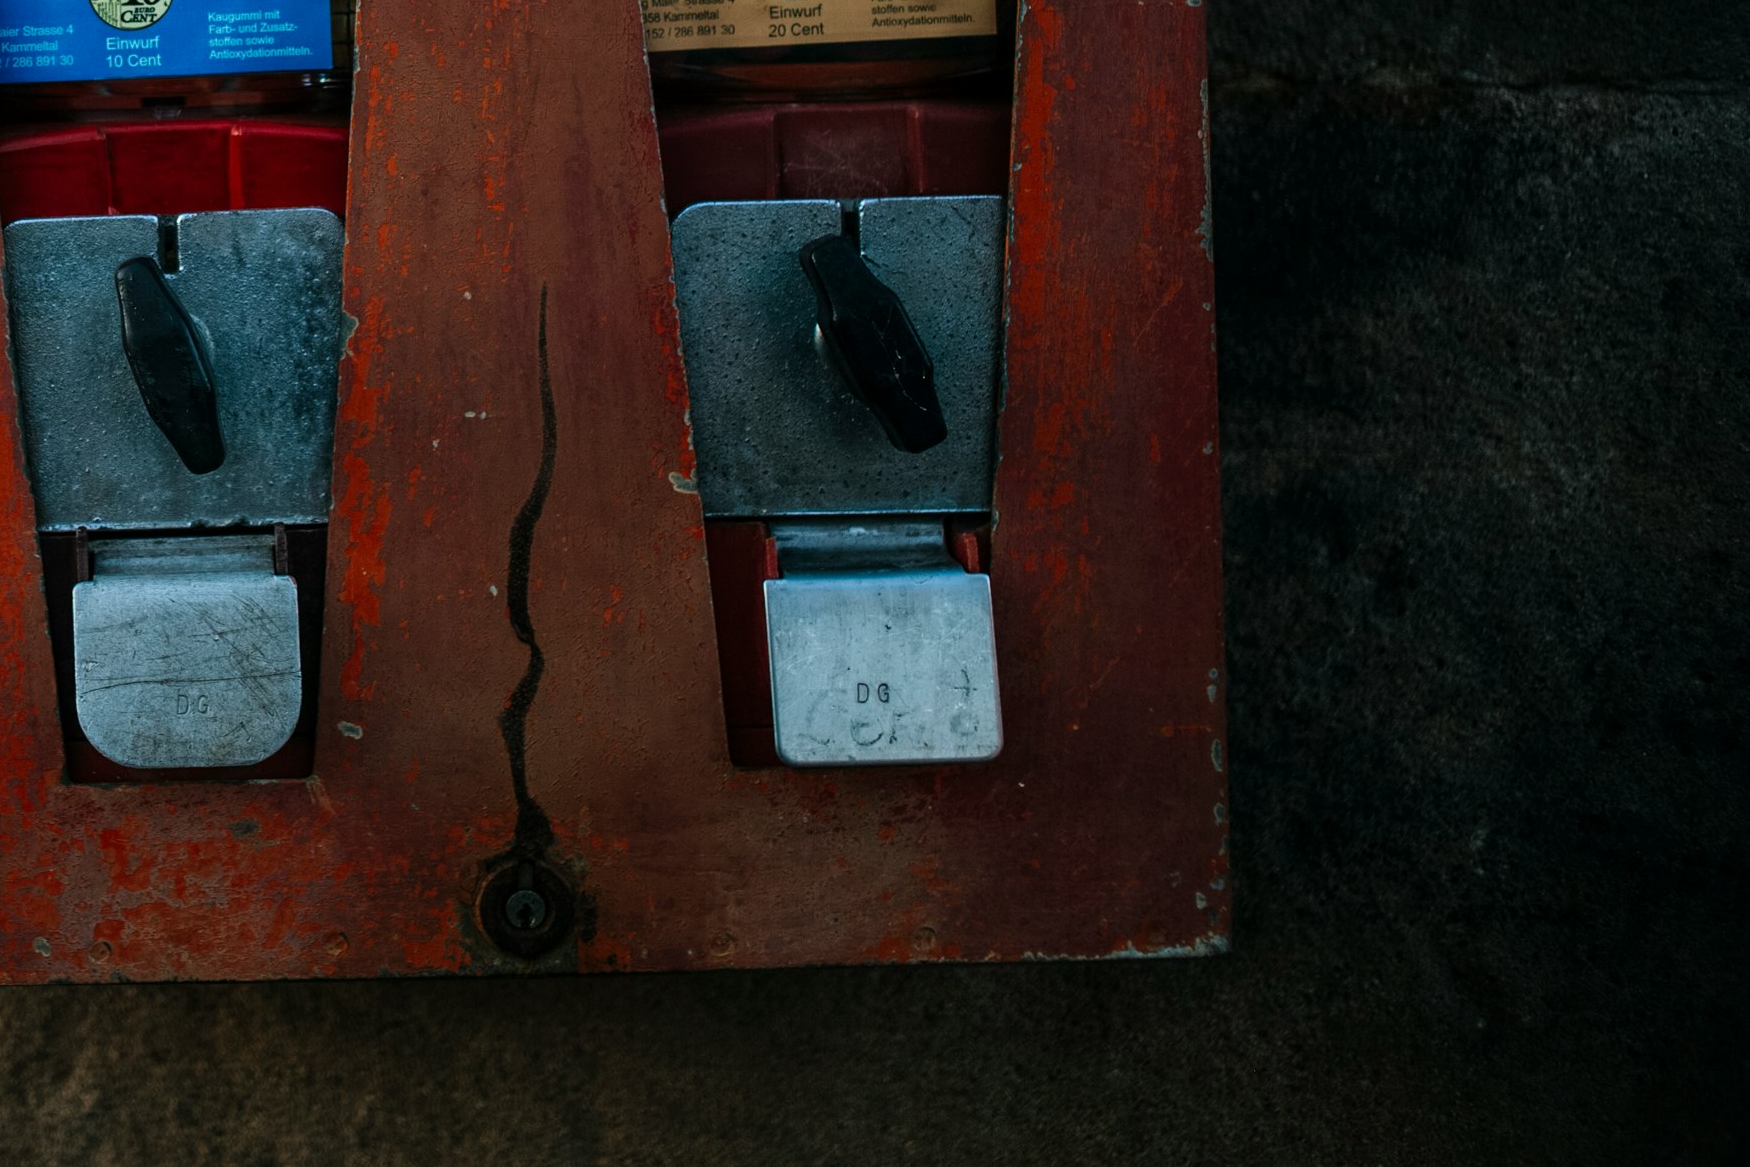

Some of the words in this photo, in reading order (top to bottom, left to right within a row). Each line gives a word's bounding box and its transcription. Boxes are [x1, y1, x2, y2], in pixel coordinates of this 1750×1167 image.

[769, 3, 823, 19] Einwurf
[872, 4, 905, 14] stoffen
[907, 2, 937, 13] sowie
[121, 11, 158, 24] CENT
[208, 10, 262, 23] Kaugummi
[264, 9, 280, 20] mit
[664, 10, 720, 22] Kammeltal
[23, 25, 63, 36] Strasse
[66, 24, 74, 35] 4
[209, 24, 236, 35] Farb-
[238, 23, 257, 33] und
[260, 22, 298, 33] Zusatz-
[674, 26, 694, 38] 286
[697, 25, 717, 37] 891
[721, 24, 736, 36] 30
[768, 25, 786, 38] 20
[791, 22, 825, 36] Cent
[2, 40, 58, 53] Kammeltal
[106, 35, 160, 50] Einwurf
[210, 36, 243, 47] stoffen
[245, 35, 274, 45] sowie
[12, 56, 33, 68] 286
[36, 55, 56, 66] 891
[60, 54, 74, 65] 30
[107, 55, 123, 68] 10
[127, 53, 162, 67] Cent
